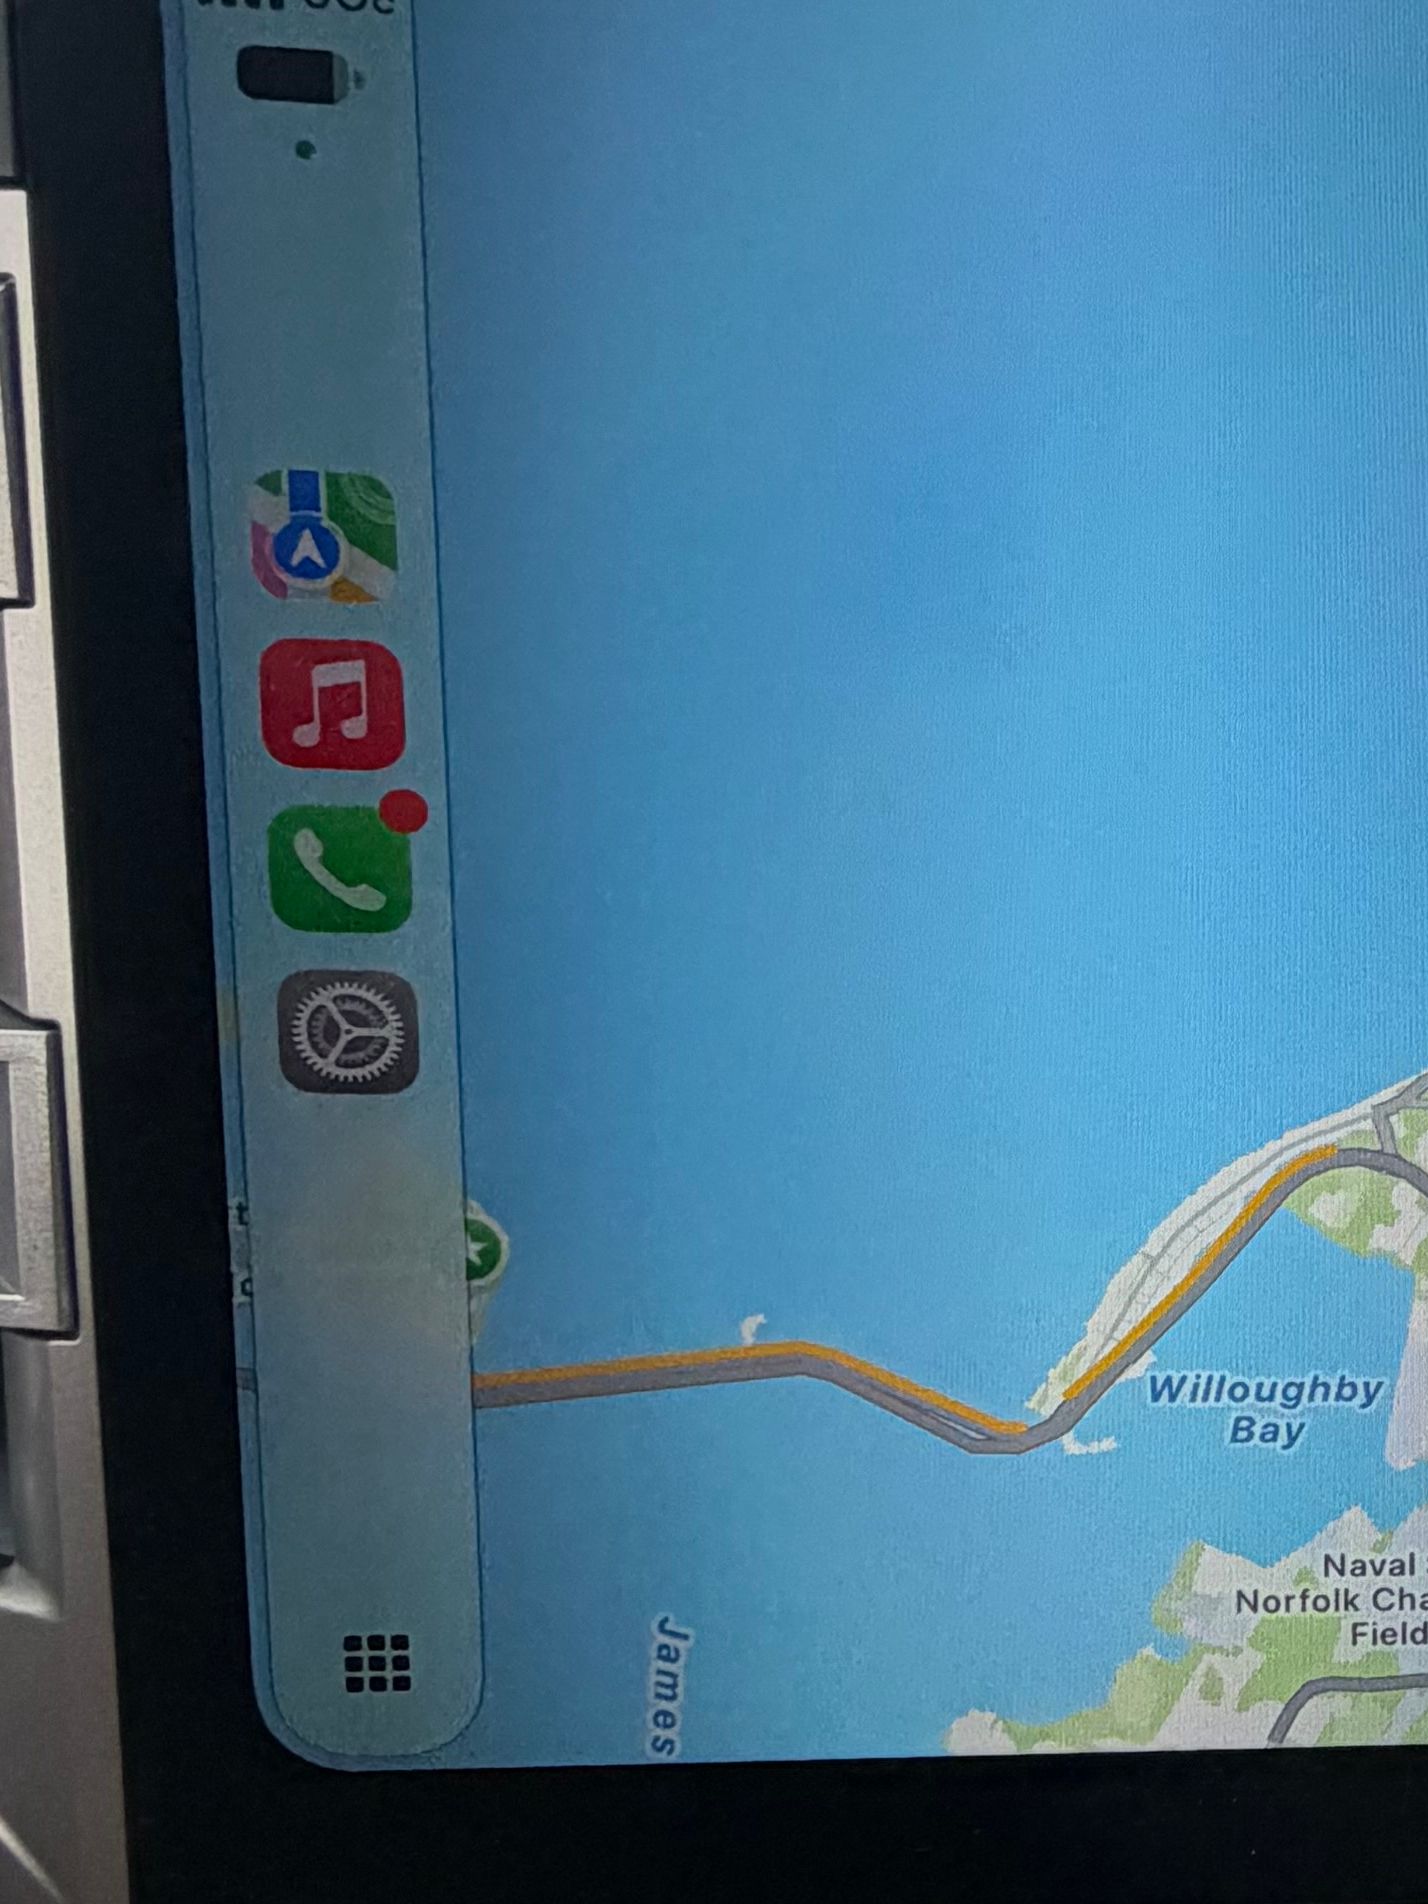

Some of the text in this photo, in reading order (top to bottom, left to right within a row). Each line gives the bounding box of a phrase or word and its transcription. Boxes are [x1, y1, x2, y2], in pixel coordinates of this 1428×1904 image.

[1148, 1373, 1385, 1408] Willoughby
[1229, 1416, 1306, 1450] Bay
[1324, 1552, 1416, 1578] Naval
[1236, 1587, 1361, 1615] Norfolk
[1351, 1621, 1428, 1647] Field
[651, 1616, 691, 1757] James
